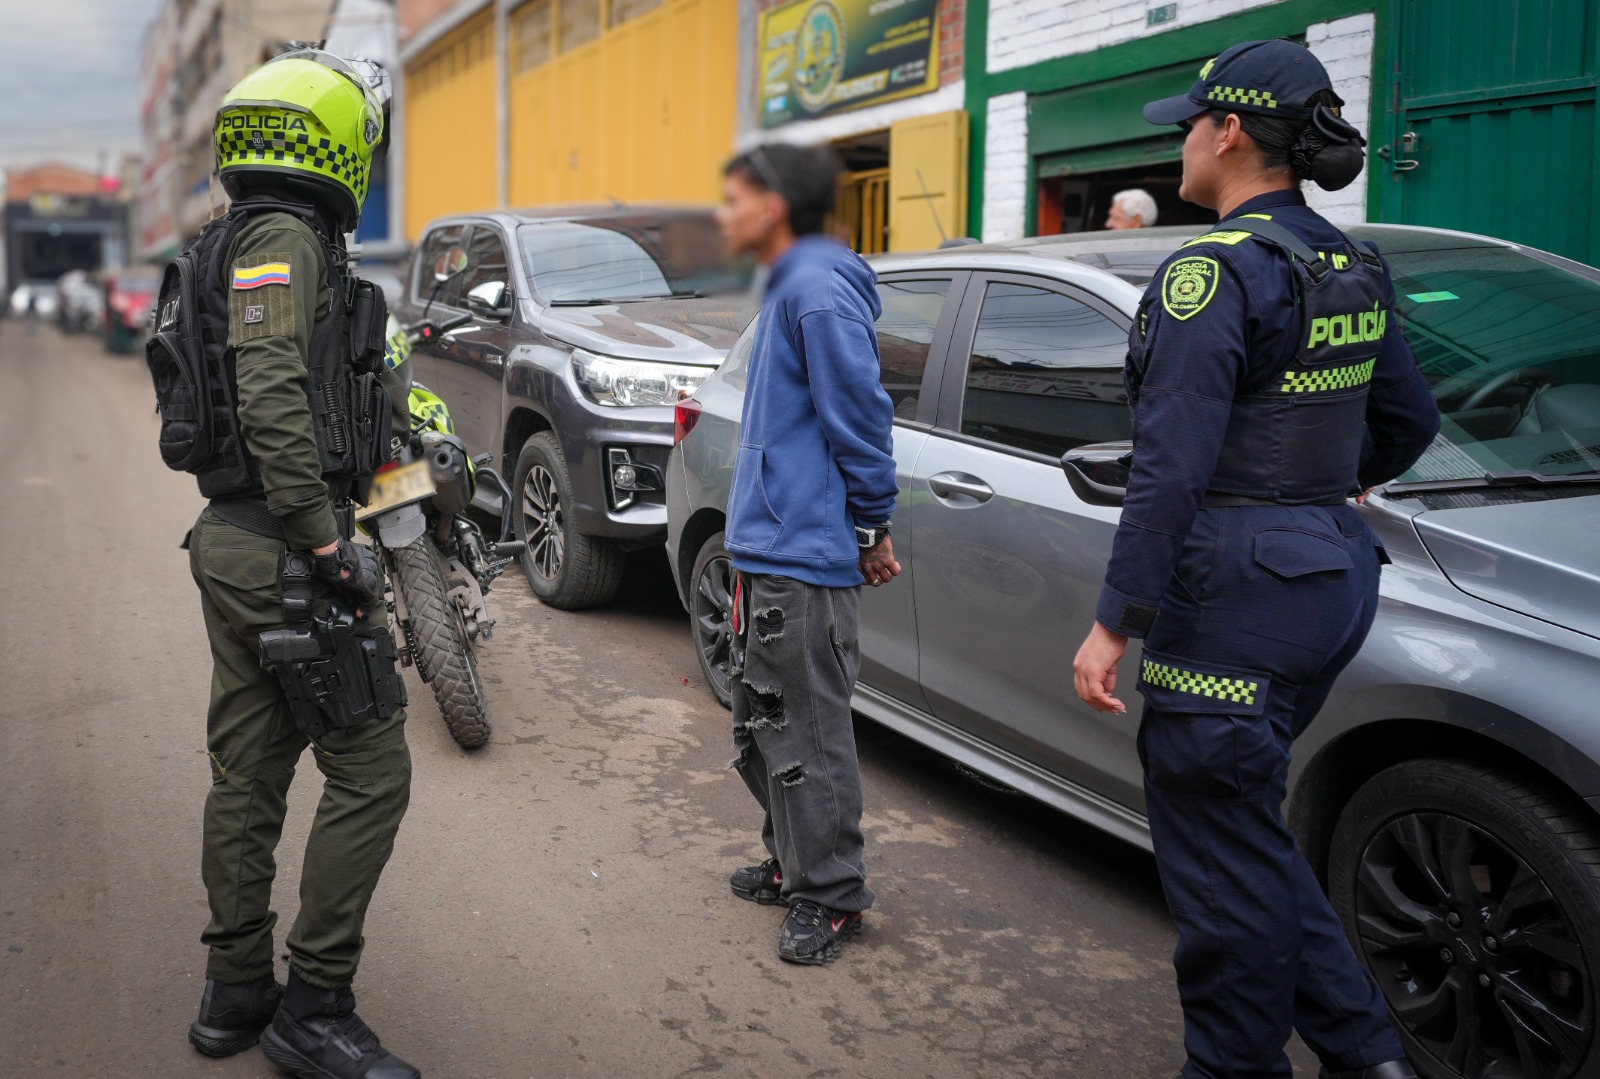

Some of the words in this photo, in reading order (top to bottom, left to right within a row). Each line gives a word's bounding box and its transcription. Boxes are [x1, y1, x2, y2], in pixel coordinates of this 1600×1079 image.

[222, 112, 308, 132] POLICÍA
[1176, 261, 1208, 270] POLICÍA
[1170, 268, 1212, 278] NACIONAL
[1169, 302, 1200, 310] COLOMBIA
[1307, 299, 1388, 349] POLICÍA
